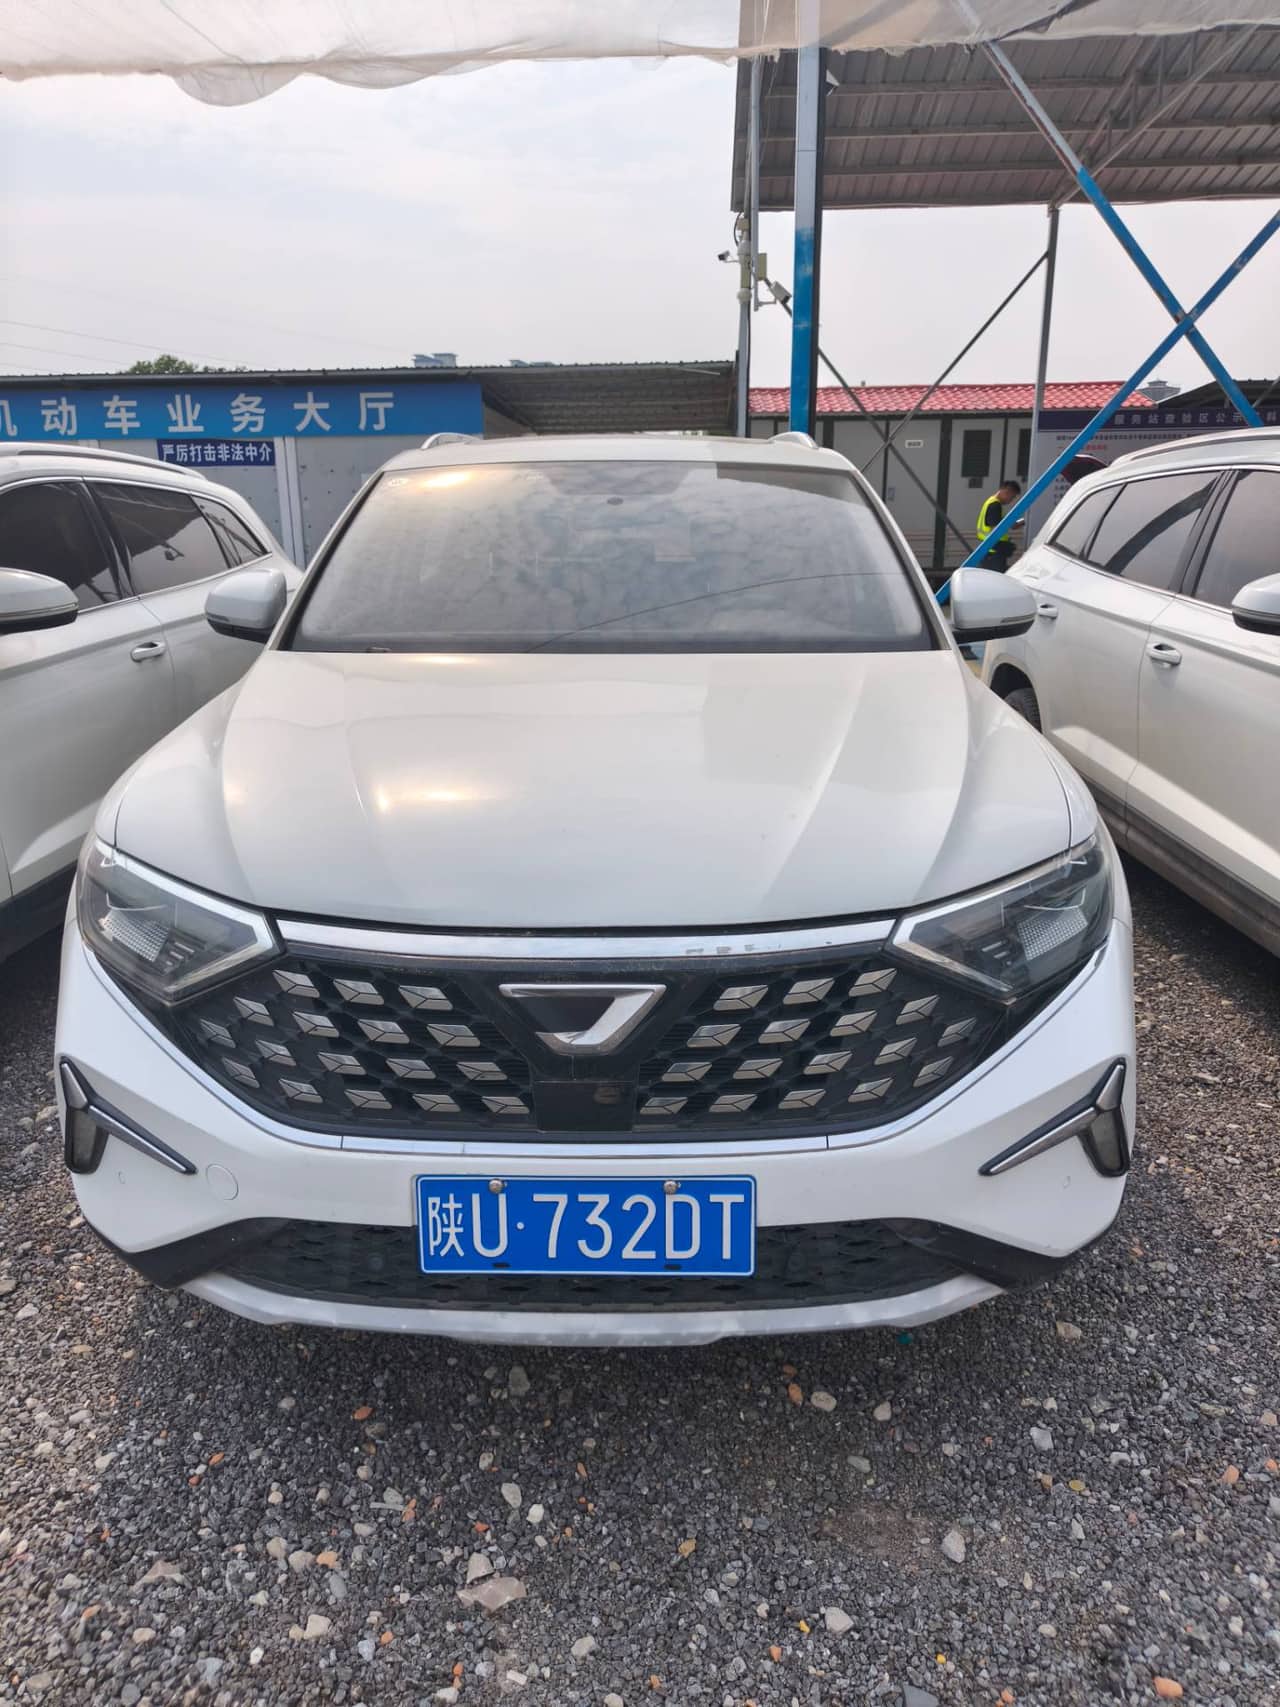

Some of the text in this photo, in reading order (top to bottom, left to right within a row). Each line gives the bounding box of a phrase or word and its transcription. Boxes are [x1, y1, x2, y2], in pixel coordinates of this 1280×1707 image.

[162, 443, 272, 463] 严厉打击非法中介
[427, 1193, 745, 1260] 陕U·732DT
